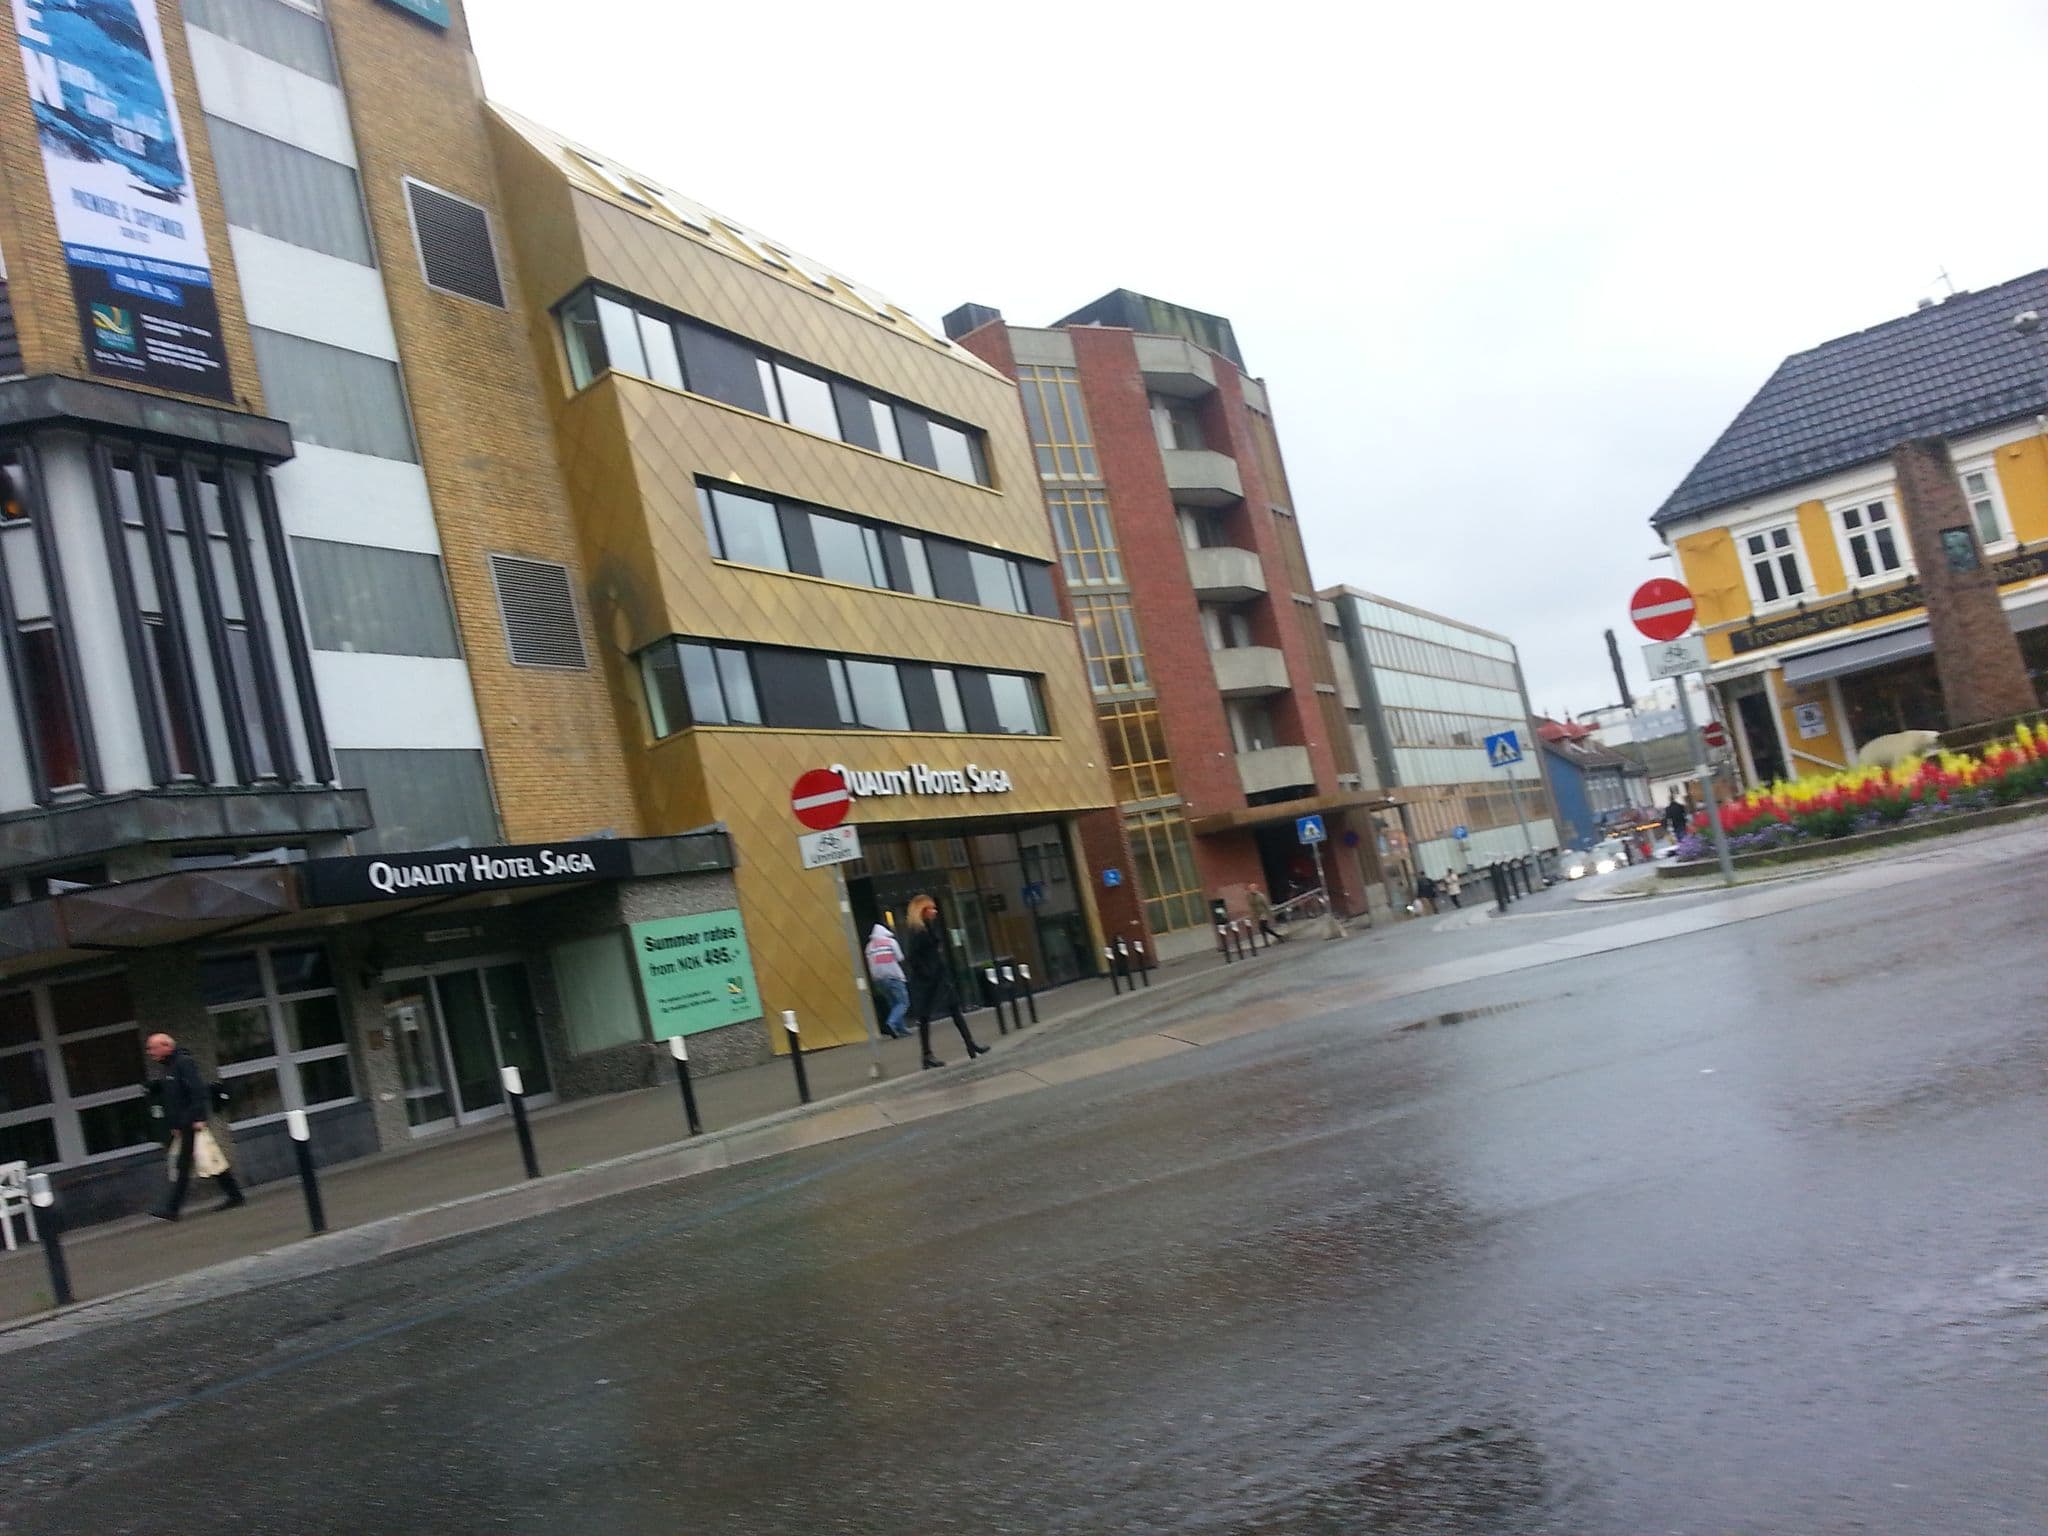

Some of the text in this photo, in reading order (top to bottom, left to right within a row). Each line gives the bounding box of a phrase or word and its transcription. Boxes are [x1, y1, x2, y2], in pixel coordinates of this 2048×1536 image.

[909, 763, 970, 796] HOTEL
[966, 763, 1013, 794] SAGA
[368, 850, 597, 894] QUALITY HOTEL SAGA
[645, 936, 700, 952] Summer
